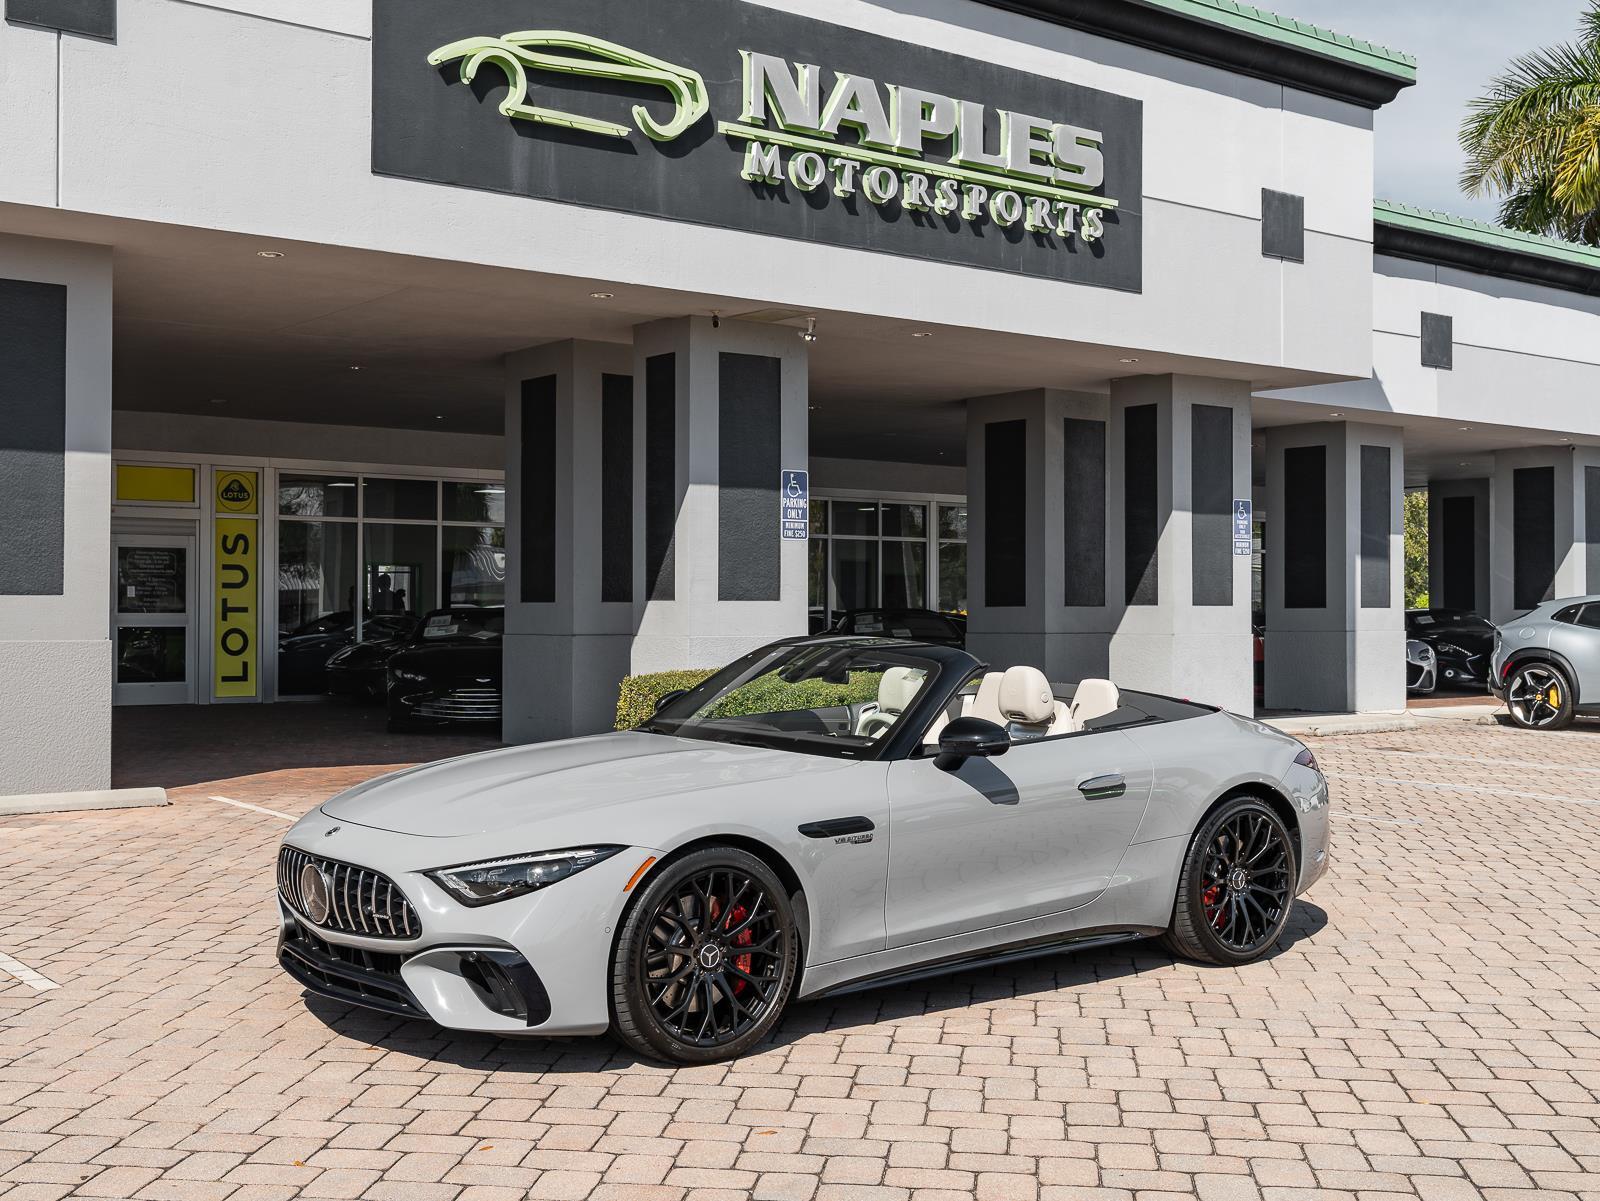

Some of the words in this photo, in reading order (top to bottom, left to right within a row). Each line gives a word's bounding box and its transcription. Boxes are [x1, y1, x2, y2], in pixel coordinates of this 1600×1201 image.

[738, 49, 1104, 191] NAPLES
[740, 140, 1104, 242] MOTORSPORTS
[223, 491, 249, 499] LOTUS
[782, 497, 807, 508] PARKING
[787, 508, 803, 519] ONLY
[220, 533, 249, 683] LOTUS
